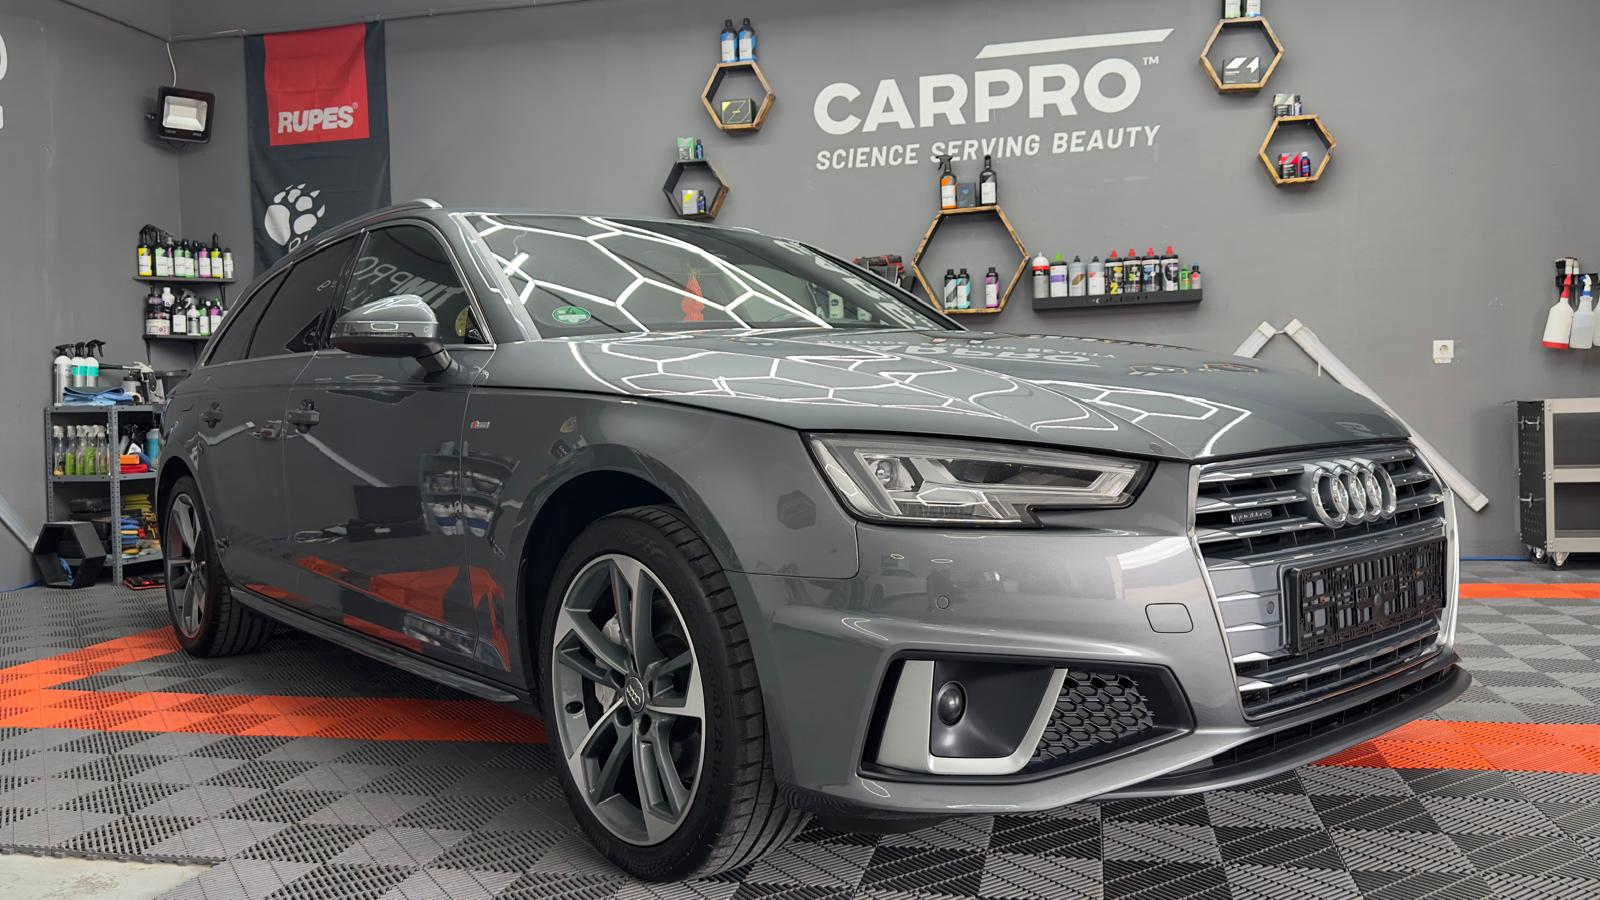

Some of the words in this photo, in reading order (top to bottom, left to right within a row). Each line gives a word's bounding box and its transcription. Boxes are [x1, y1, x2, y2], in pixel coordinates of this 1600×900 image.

[813, 57, 1142, 135] CARPRO
[816, 143, 921, 171] SCIENCE
[930, 133, 1041, 164] SERVING
[1051, 125, 1161, 155] BEAUTY
